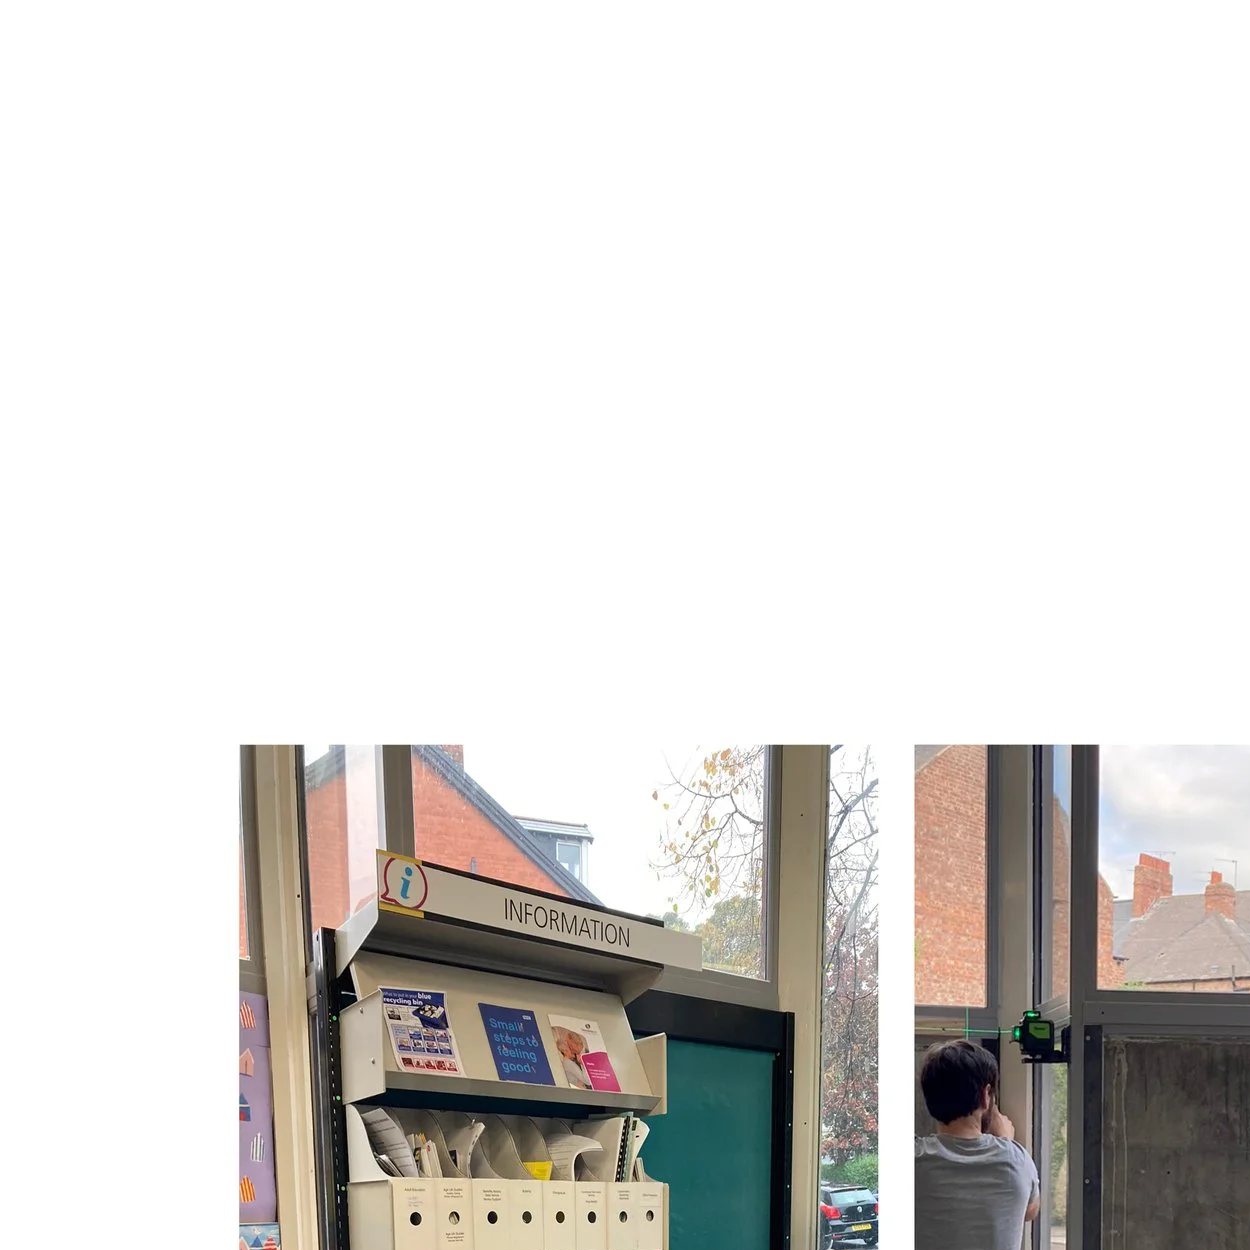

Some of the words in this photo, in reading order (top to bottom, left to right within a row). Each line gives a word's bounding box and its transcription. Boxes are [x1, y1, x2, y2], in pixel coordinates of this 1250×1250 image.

[504, 898, 630, 948] INFORMATION
[383, 997, 412, 1006] recycling
[412, 998, 423, 1006] bin
[417, 992, 431, 1000] blue
[489, 1017, 521, 1032] Small
[494, 1032, 525, 1047] steps
[528, 1036, 539, 1048] to
[497, 1046, 537, 1063] feeling
[502, 1061, 531, 1073] good
